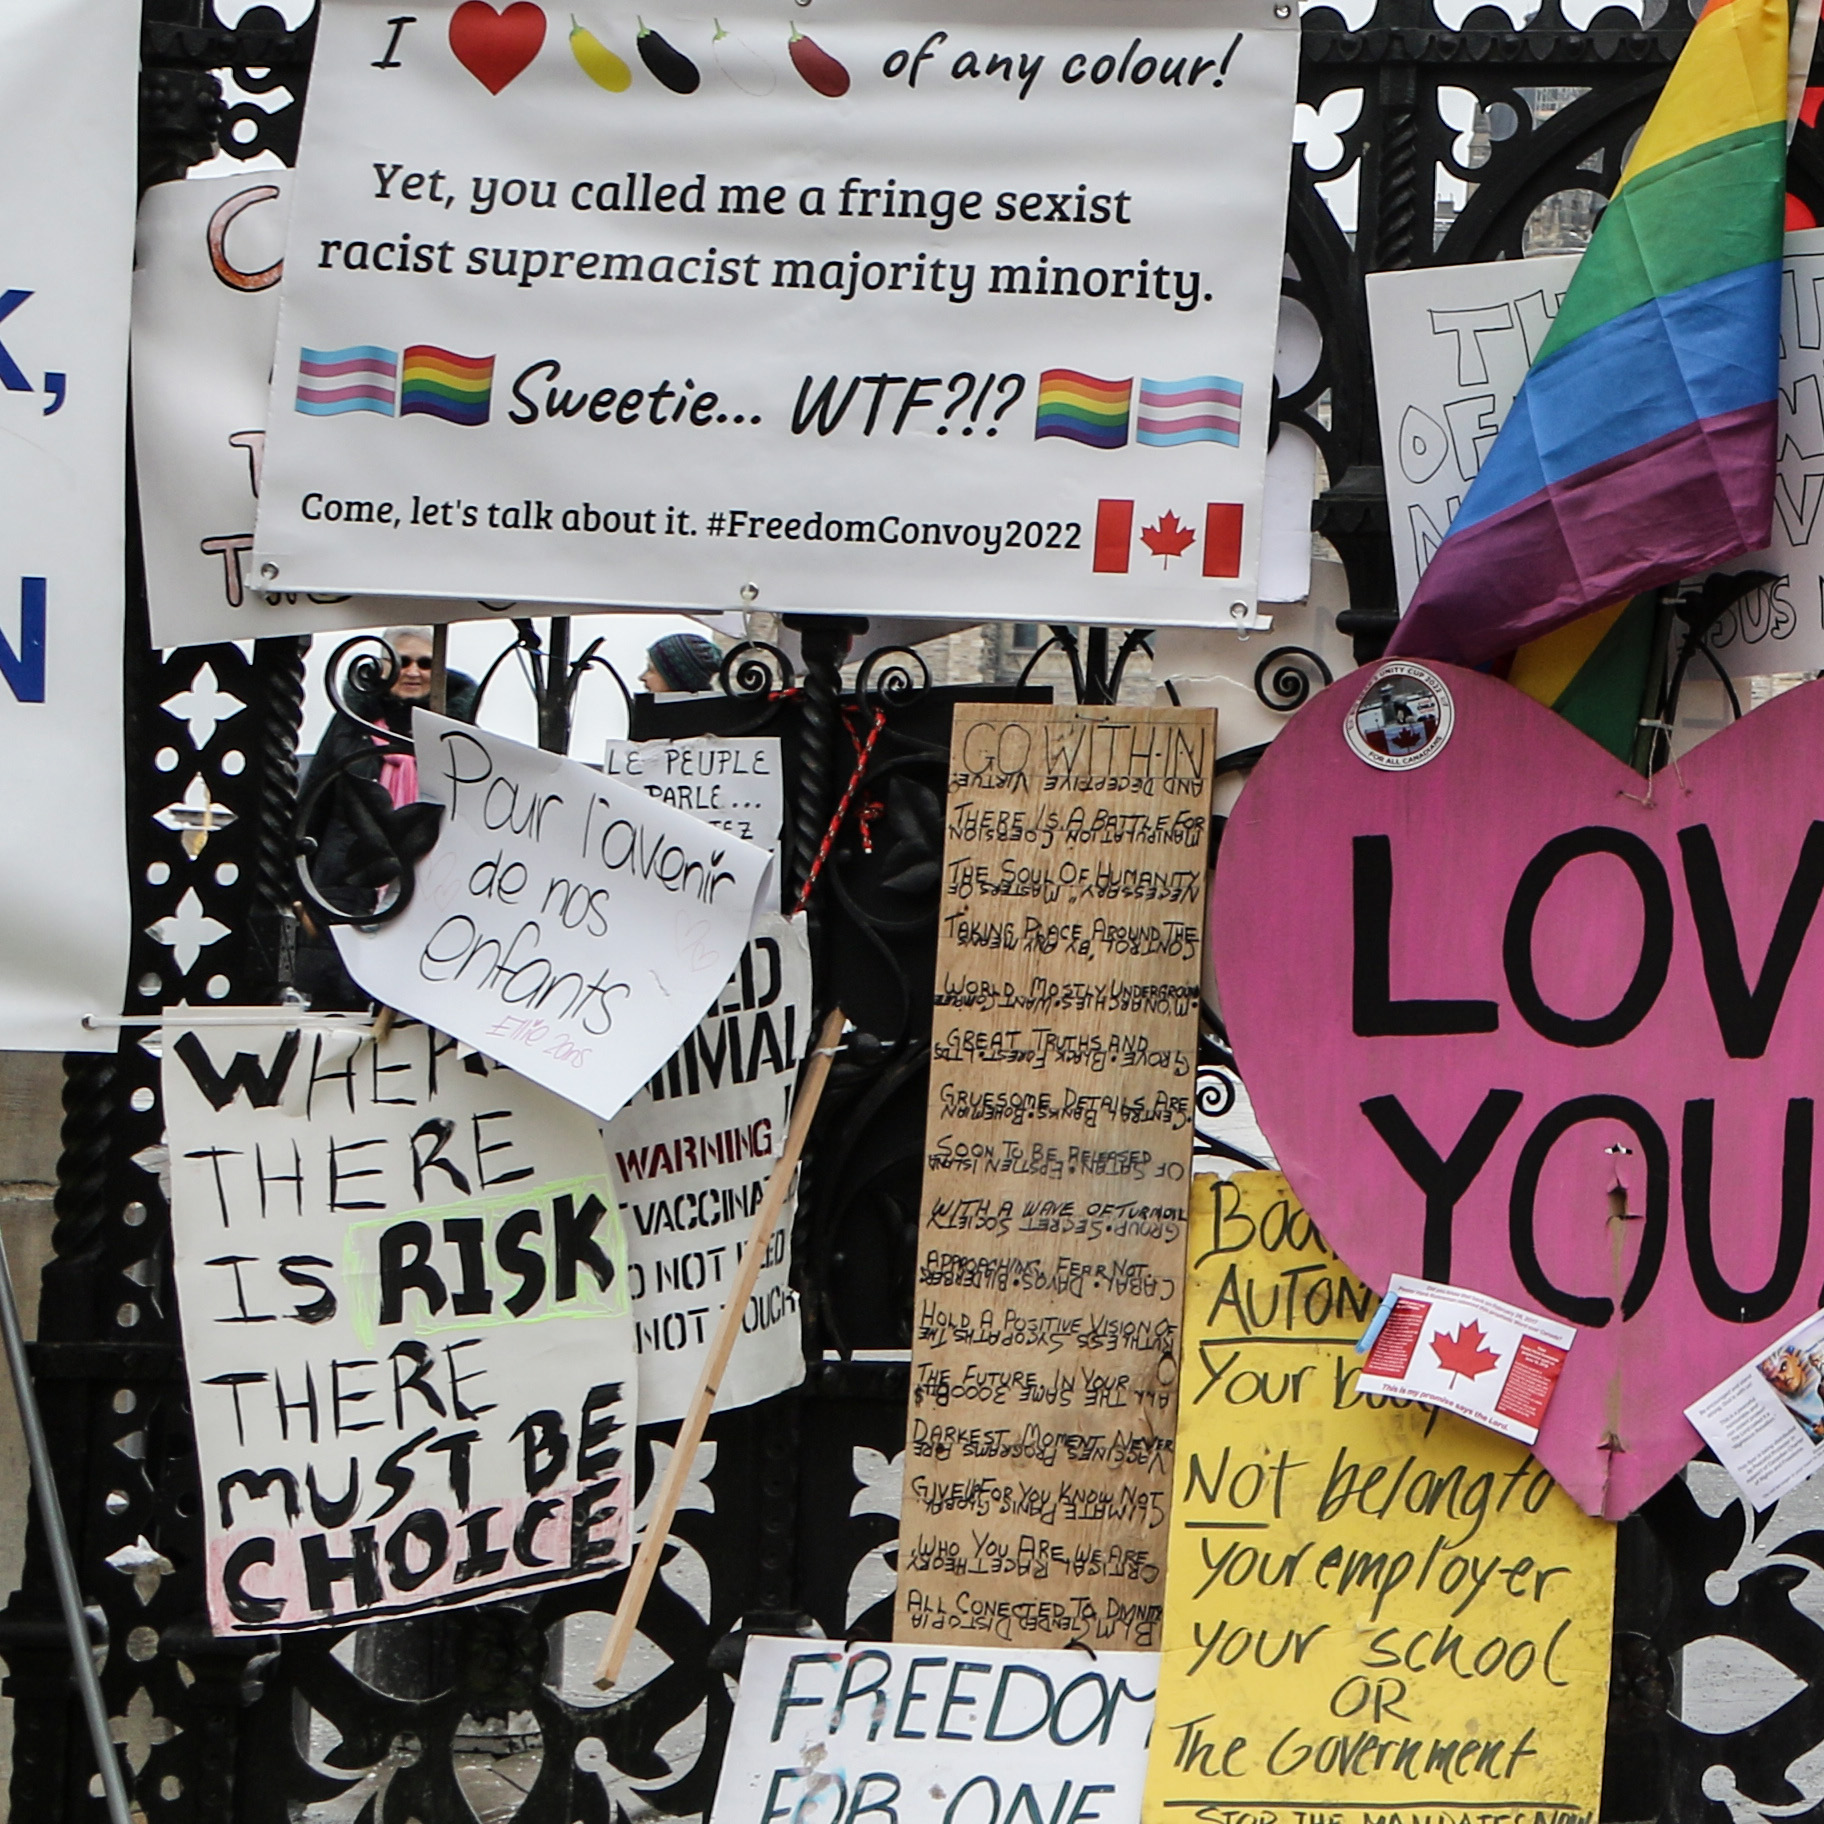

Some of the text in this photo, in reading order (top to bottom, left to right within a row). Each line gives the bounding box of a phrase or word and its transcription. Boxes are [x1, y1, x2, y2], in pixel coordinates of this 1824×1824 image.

[370, 16, 1244, 93] I of any colour!
[372, 162, 1132, 231] Yet, you called me a fringe sexist
[317, 232, 455, 274] racist
[465, 246, 761, 288] supremacist
[771, 250, 976, 304] majority
[987, 255, 1213, 312] minority.
[507, 359, 1026, 438] Sweetie... WTF?!?
[300, 491, 1082, 555] Come, let's talk about it. #FreedomConvoy2022
[1407, 669, 1425, 677] CUP
[607, 748, 771, 777] LE PEUPLE
[963, 723, 1031, 776] GO
[1368, 751, 1384, 763] FOR
[1402, 737, 1442, 764] CANADIANS
[439, 730, 564, 841] Pour
[954, 802, 1026, 829] THERE
[1068, 806, 1085, 831] A
[1094, 809, 1171, 831] BATTLE
[1173, 810, 1205, 831] FOR
[468, 849, 610, 937] de nos
[1001, 859, 1200, 886] SOUL OF HUMANITY
[419, 907, 631, 1035] enfants
[947, 1028, 1148, 1052] GREAT TRUTHS AND
[183, 1110, 535, 1228] THERE
[614, 1117, 772, 1184] WARNING
[204, 1193, 615, 1326] IS RISK
[655, 1246, 727, 1294] NOT
[921, 1299, 1082, 1332] HOLD POSITIVE
[200, 1338, 498, 1446] THERE
[1419, 1391, 1455, 1407] promise
[1455, 1401, 1473, 1416] says
[1474, 1408, 1488, 1423] the
[217, 1381, 627, 1531] MUST BE
[1183, 1446, 1496, 1550] Not belong
[221, 1474, 627, 1624] CHOICE
[1365, 1617, 1573, 1688] school
[1329, 1675, 1412, 1724] OR
[1168, 1713, 1538, 1785] The Government
